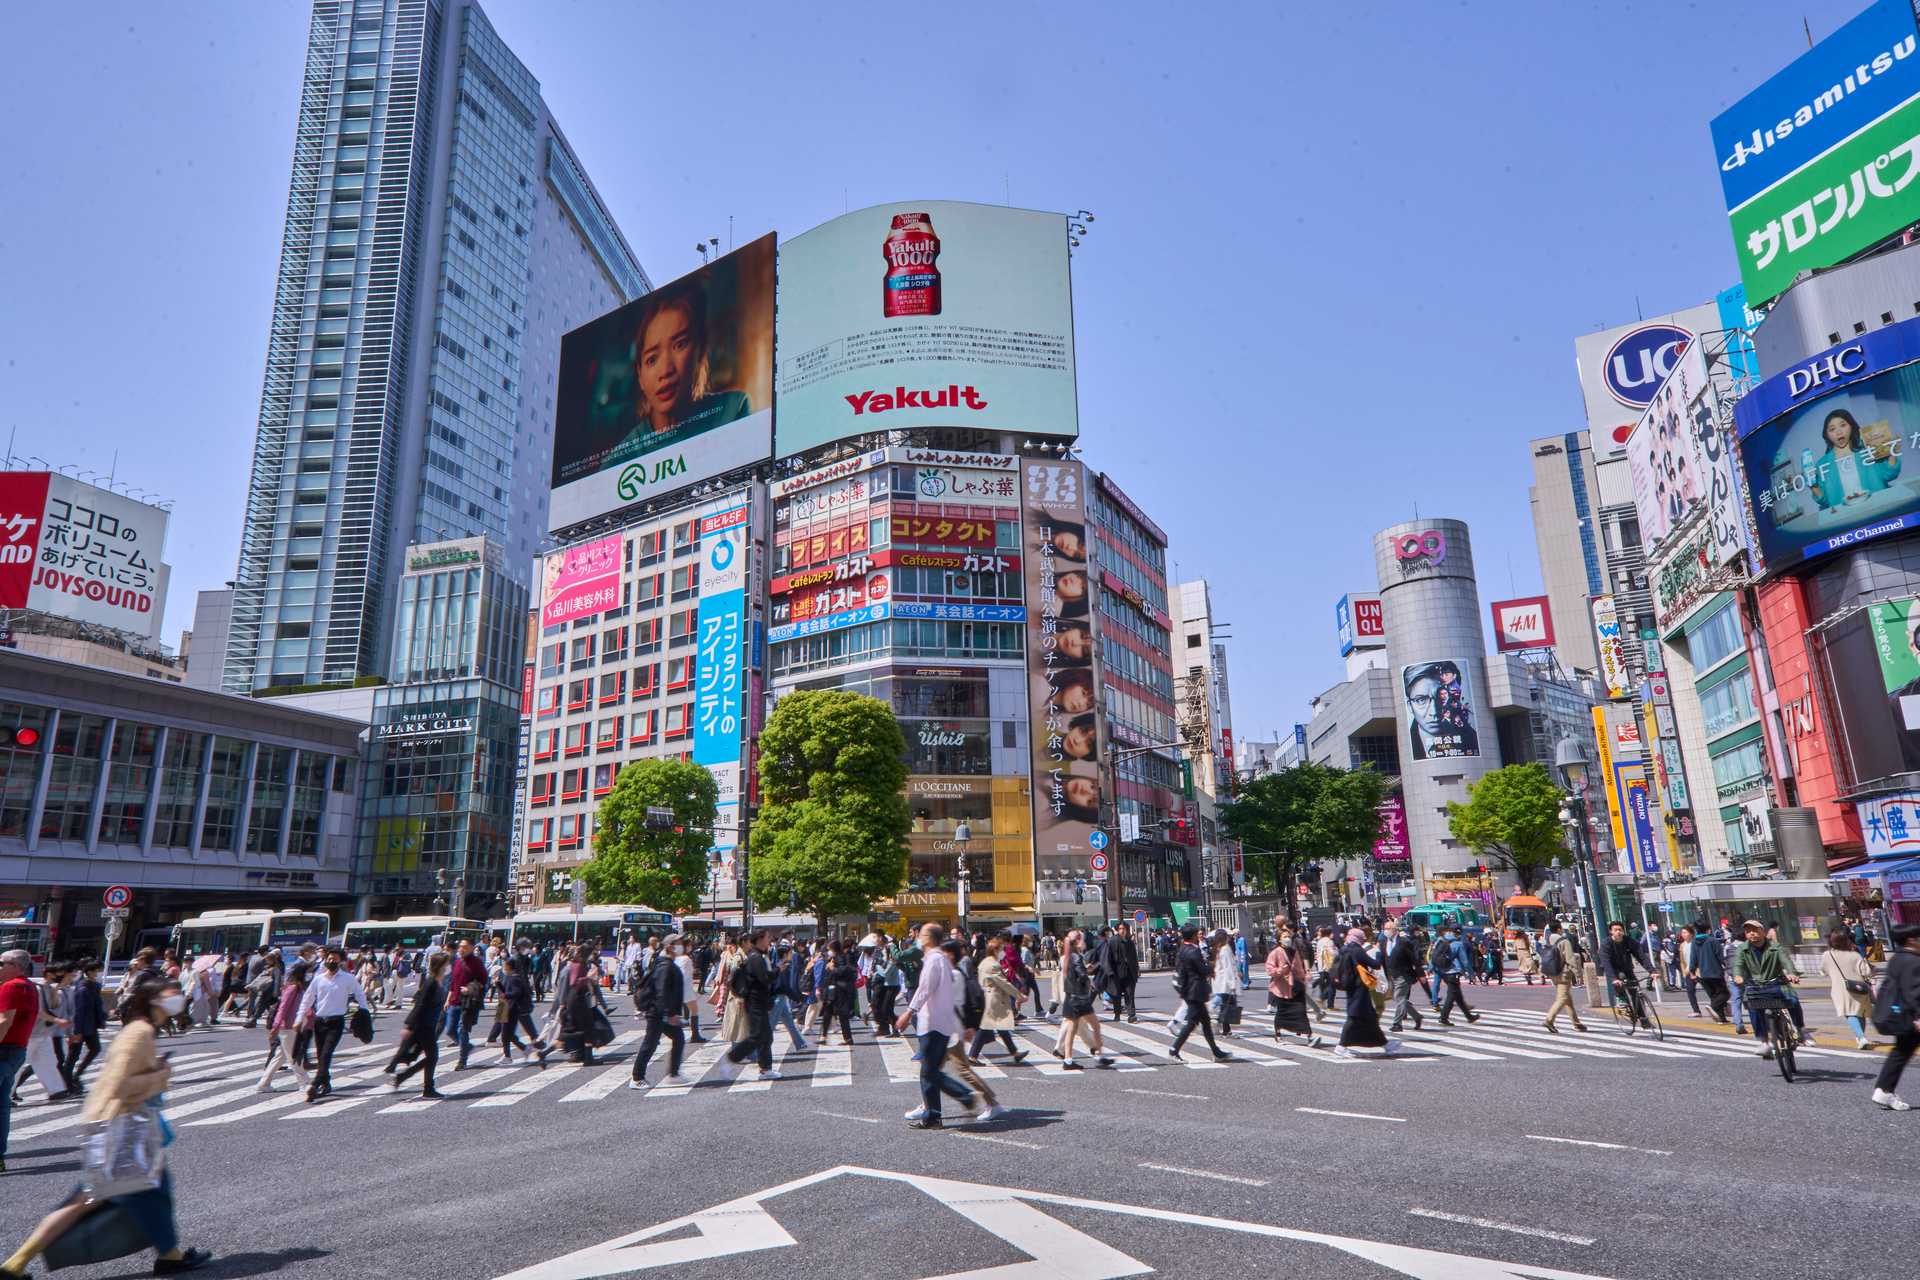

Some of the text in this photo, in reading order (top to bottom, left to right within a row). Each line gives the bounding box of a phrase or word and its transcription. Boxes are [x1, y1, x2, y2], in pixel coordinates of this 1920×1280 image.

[1721, 34, 1916, 171] Hisamitsu
[888, 239, 935, 254] Yakult
[889, 251, 933, 267] 1000
[1613, 340, 1690, 388] UC
[1786, 344, 1865, 398] DHC
[844, 384, 988, 416] Yakult
[649, 454, 687, 483] JRA
[906, 450, 1013, 468] しゃぶしゃぶバイキング
[817, 480, 865, 509] しゃぶ葉
[951, 475, 1014, 497] しゃぶ葉
[49, 497, 137, 543] ココロの
[704, 512, 743, 531] 当ビル5F
[776, 507, 790, 521] 9F
[892, 519, 992, 542] コンタクト
[1829, 519, 1905, 549] DHC Channel
[1390, 531, 1447, 567] 109
[41, 547, 155, 593] あげていこう。
[835, 557, 874, 580] ガスト
[963, 553, 1010, 573] ガスト
[33, 565, 152, 614] JOYSOUND
[703, 570, 739, 588] eyecity
[553, 586, 615, 617] 品川美容外科
[773, 603, 790, 620] 7F
[815, 585, 861, 615] ガスト
[1359, 604, 1380, 617] UN
[800, 610, 868, 634] 英会話イーオン
[936, 605, 1023, 619] 英会話イーオン
[1509, 614, 1537, 633] H&M
[1361, 619, 1382, 633] QL
[701, 615, 722, 737] アイシティ
[720, 611, 738, 735] コンタクトの
[379, 719, 473, 735] MARK CITY
[402, 712, 447, 722] SHIBUYA
[914, 782, 972, 792] L'OCCITANE
[1866, 806, 1920, 843] 大盛
